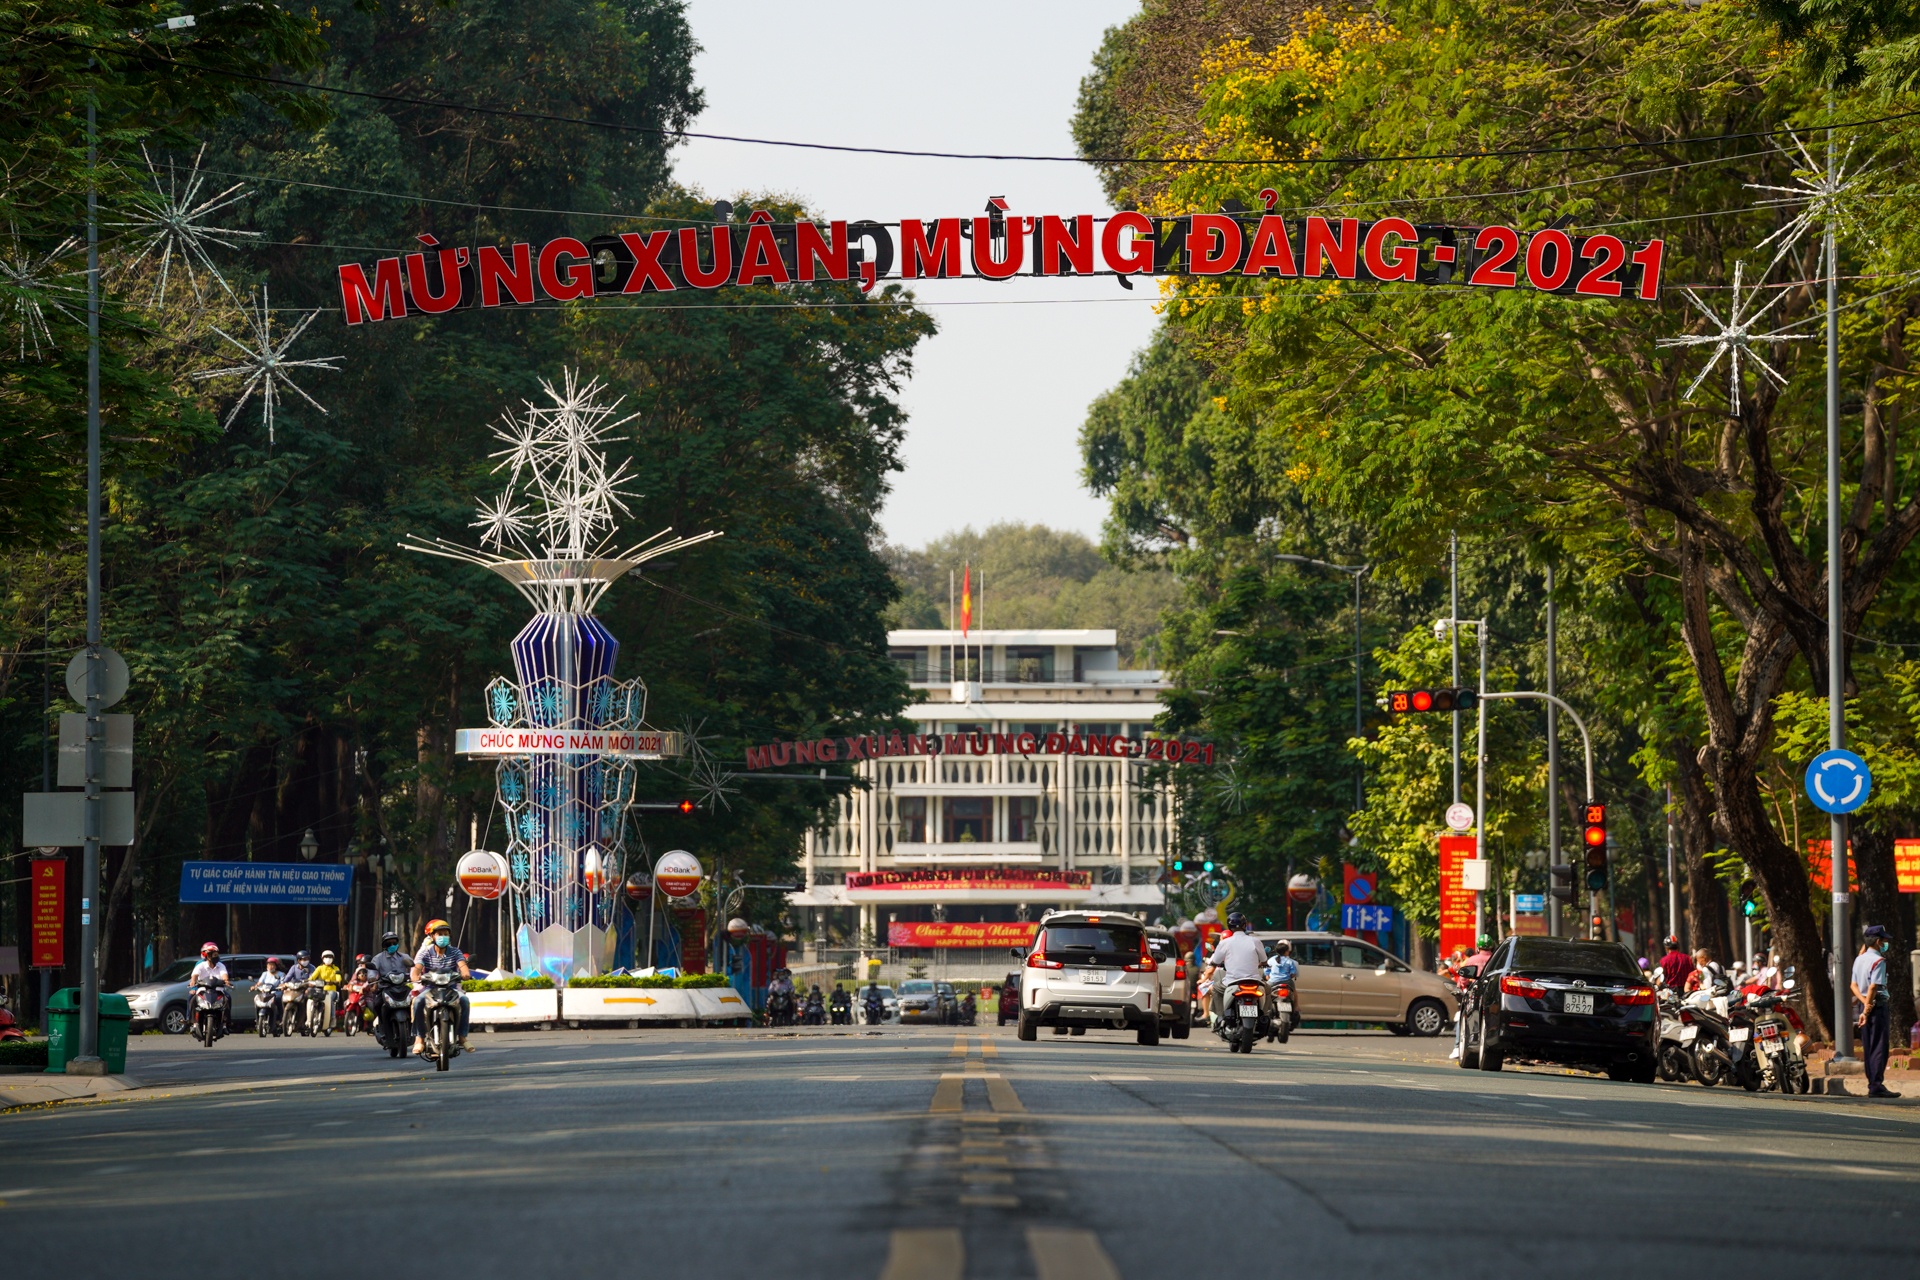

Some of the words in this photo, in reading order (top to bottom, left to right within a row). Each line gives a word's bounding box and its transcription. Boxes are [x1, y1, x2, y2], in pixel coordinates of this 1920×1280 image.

[338, 233, 594, 325] MỪNG
[620, 209, 876, 294] XUÂN,
[900, 194, 1155, 278] MỪNG
[1186, 188, 1419, 282] ĐẢNG
[1470, 225, 1665, 300] 2021
[480, 731, 514, 748] CHÚC
[518, 731, 565, 749] MỪNG
[570, 732, 603, 750] NĂM
[608, 733, 635, 750] MỚI
[639, 736, 662, 751] 2021
[746, 738, 837, 770] MỪNG
[845, 729, 937, 760] XUÂN,
[945, 727, 1036, 756] MỪNG
[1046, 724, 1128, 757] ĐẢNG
[1147, 738, 1214, 765] 2021
[190, 868, 202, 880] TỰ
[203, 868, 221, 879] GIÁC
[222, 866, 243, 879] CHẤP
[245, 868, 266, 880] HÀNH
[268, 869, 280, 880] TÍN
[282, 869, 300, 881] HIỆU
[302, 871, 319, 880] GIAO
[320, 870, 345, 881] THÔNG
[204, 883, 213, 893] LÀ
[216, 879, 232, 893] THỂ
[233, 884, 252, 895] HIỆN
[270, 884, 286, 894] HÓA
[288, 885, 305, 895] GIAO
[307, 884, 331, 895] THÔNG
[915, 924, 945, 937] Chúc
[950, 925, 984, 938] Mừng
[988, 924, 1020, 937] Năm
[935, 939, 963, 947] HAPPY
[1011, 938, 1028, 946] 2021
[1571, 994, 1587, 1004] 51A
